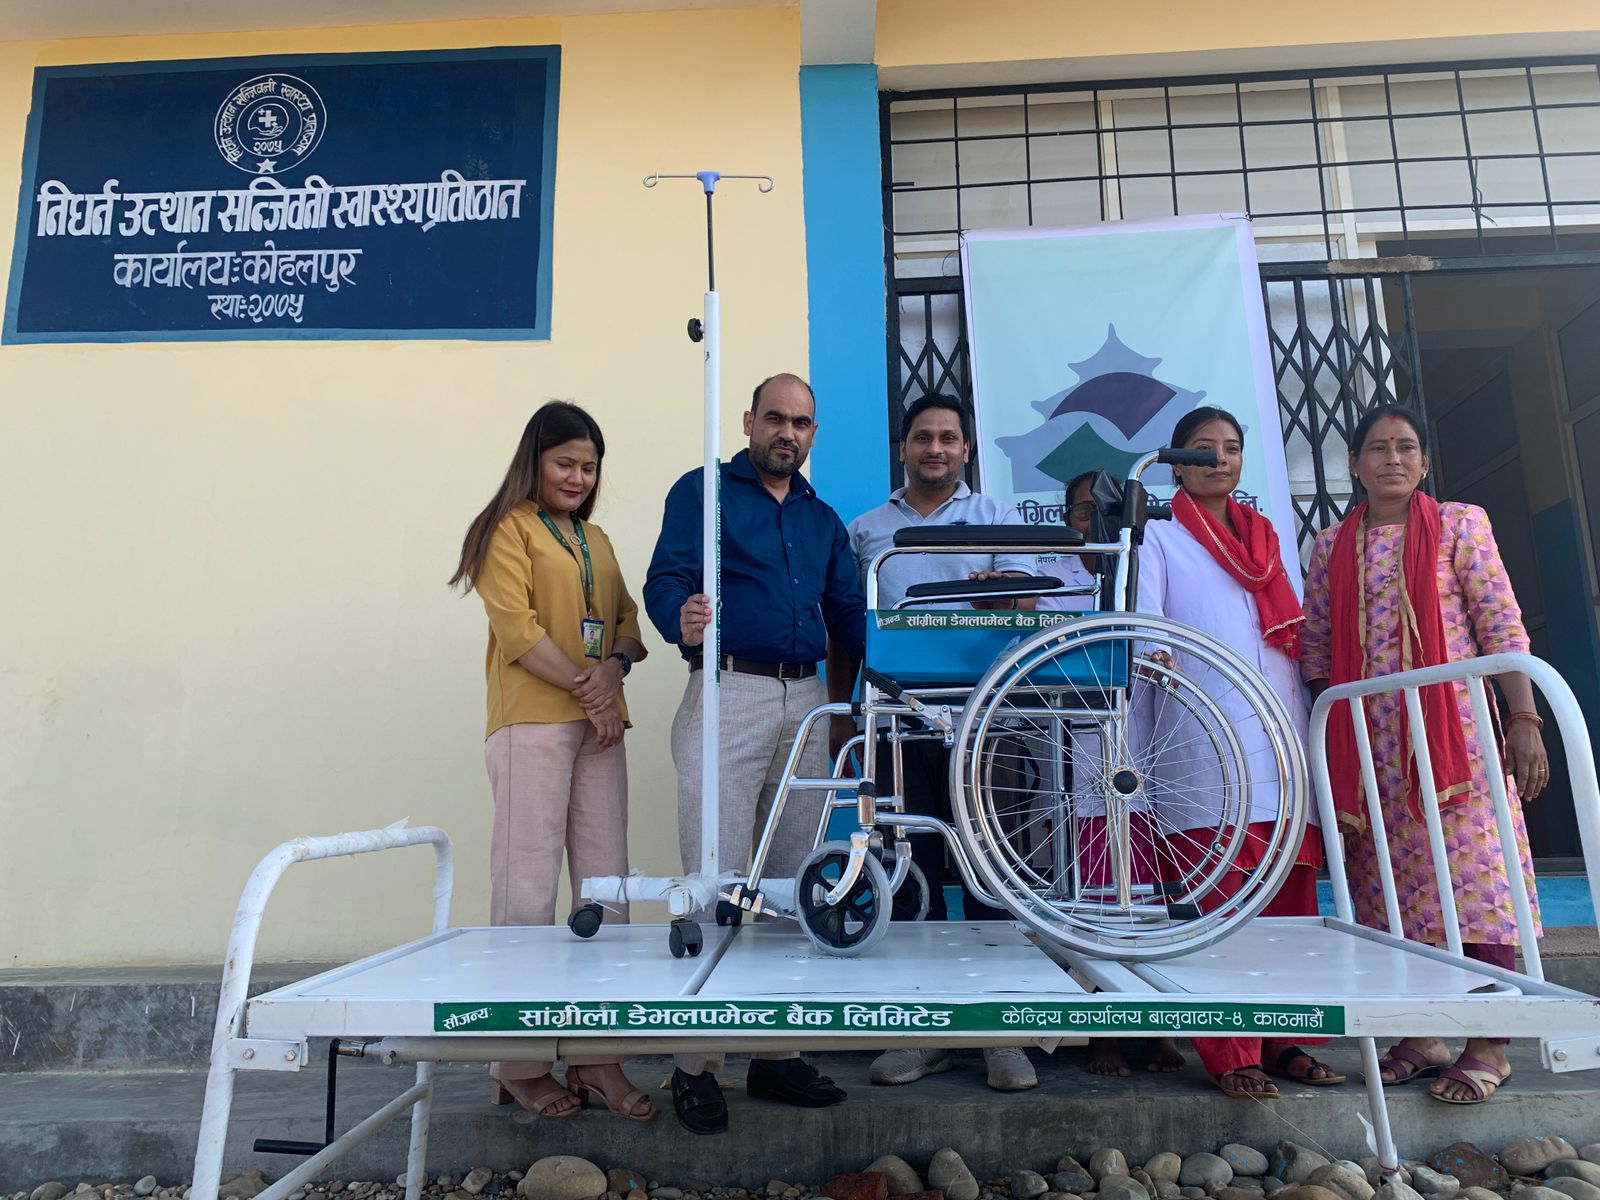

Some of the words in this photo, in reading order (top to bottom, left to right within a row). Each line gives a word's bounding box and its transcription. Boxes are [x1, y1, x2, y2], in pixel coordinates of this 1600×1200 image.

[253, 140, 283, 155] २०७५
[119, 190, 217, 236] उत्थान
[518, 1004, 619, 1028] सांग्रीला
[627, 1003, 778, 1026] डेभलपमेन्ट
[843, 1004, 953, 1027] लिमिटेड
[1068, 1004, 1142, 1025] कार्यालय
